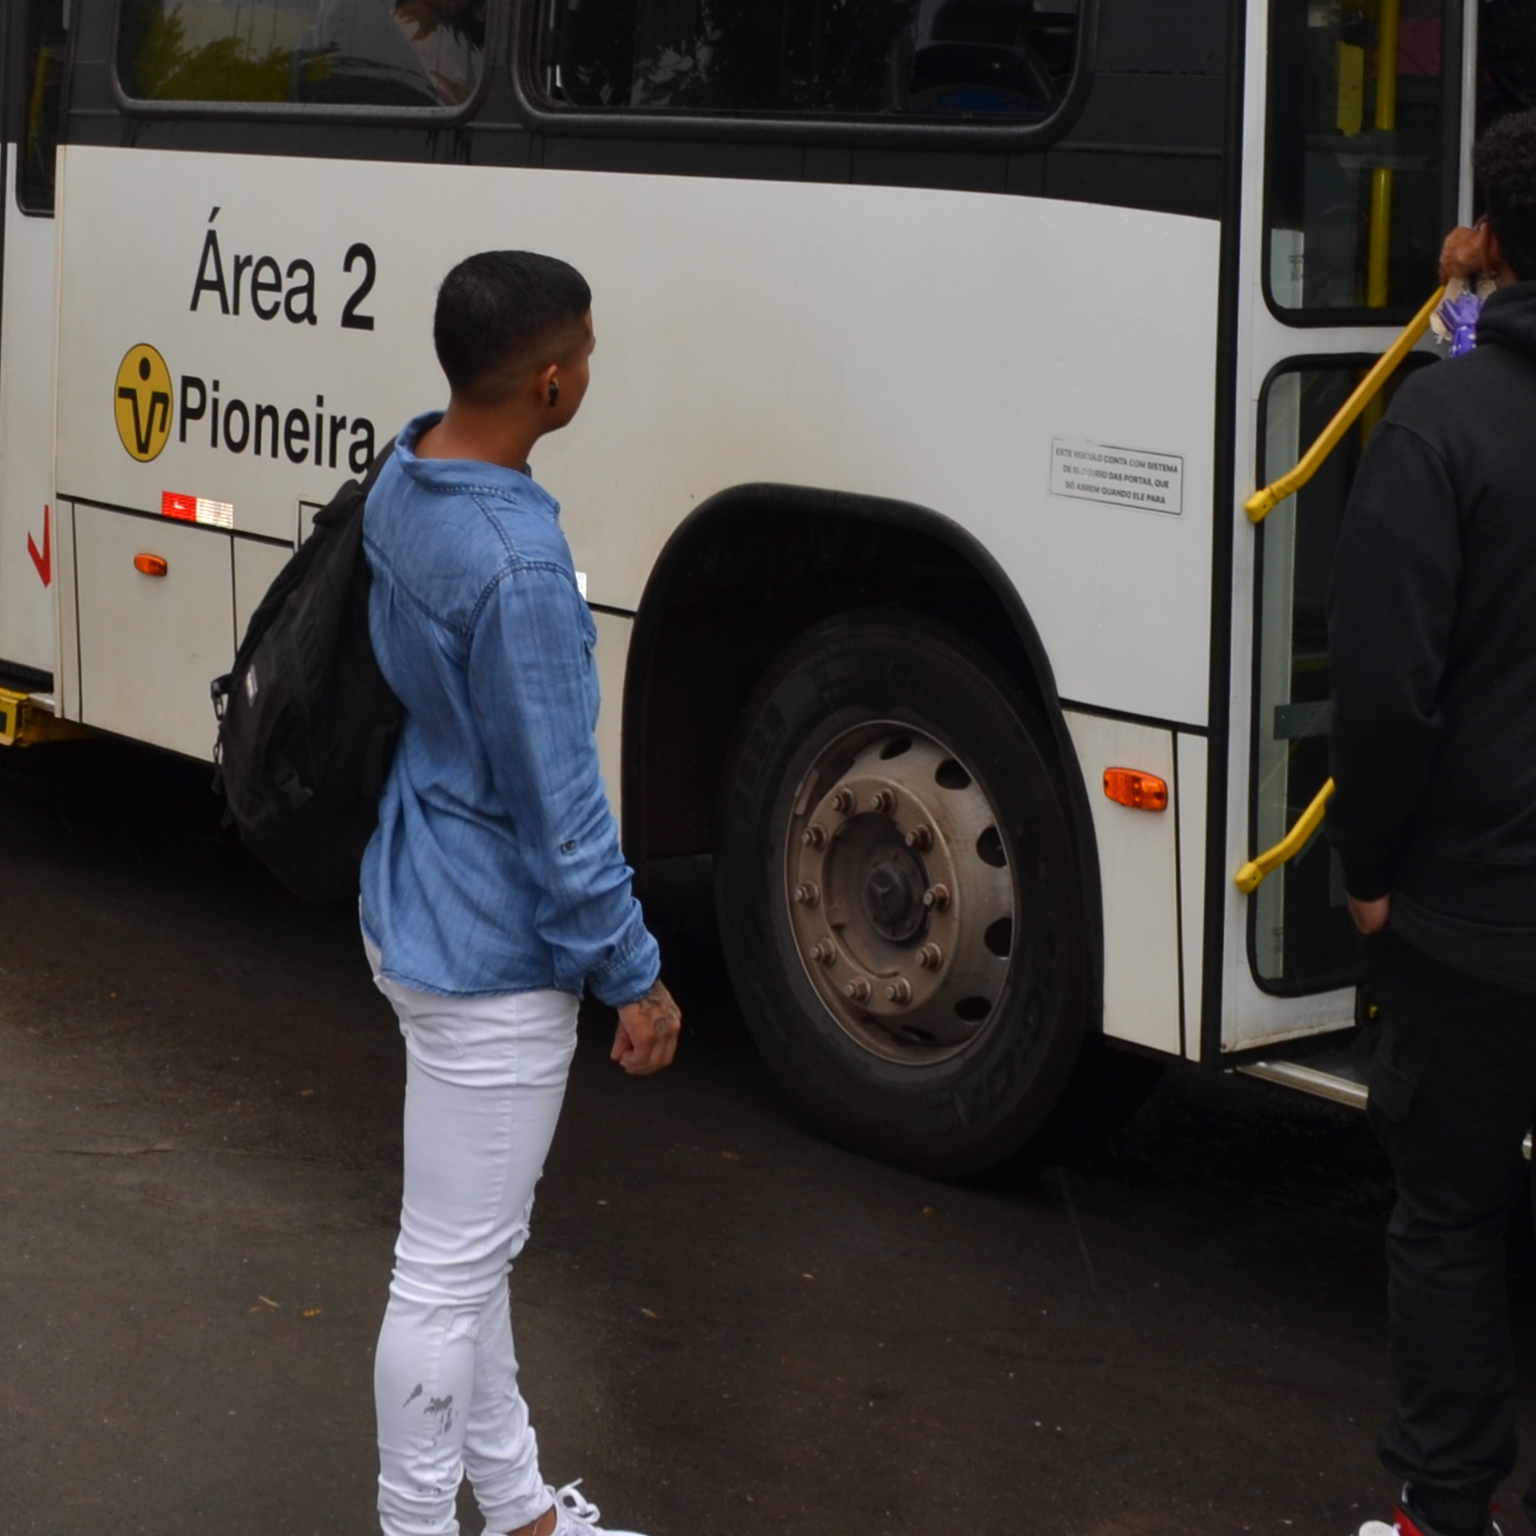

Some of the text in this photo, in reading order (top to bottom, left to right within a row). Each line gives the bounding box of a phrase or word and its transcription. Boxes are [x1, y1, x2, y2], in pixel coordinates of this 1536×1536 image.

[189, 206, 378, 332] Área 2
[179, 375, 376, 475] Pioneira
[1104, 455, 1128, 466] CONTA
[1129, 459, 1146, 469] COM
[1147, 461, 1179, 474] SISTEMA
[1109, 471, 1123, 482] DAS
[1154, 478, 1170, 490] QUE
[1101, 486, 1132, 500] QUANDO
[1133, 490, 1146, 502] ELE
[1146, 492, 1166, 505] PARA
